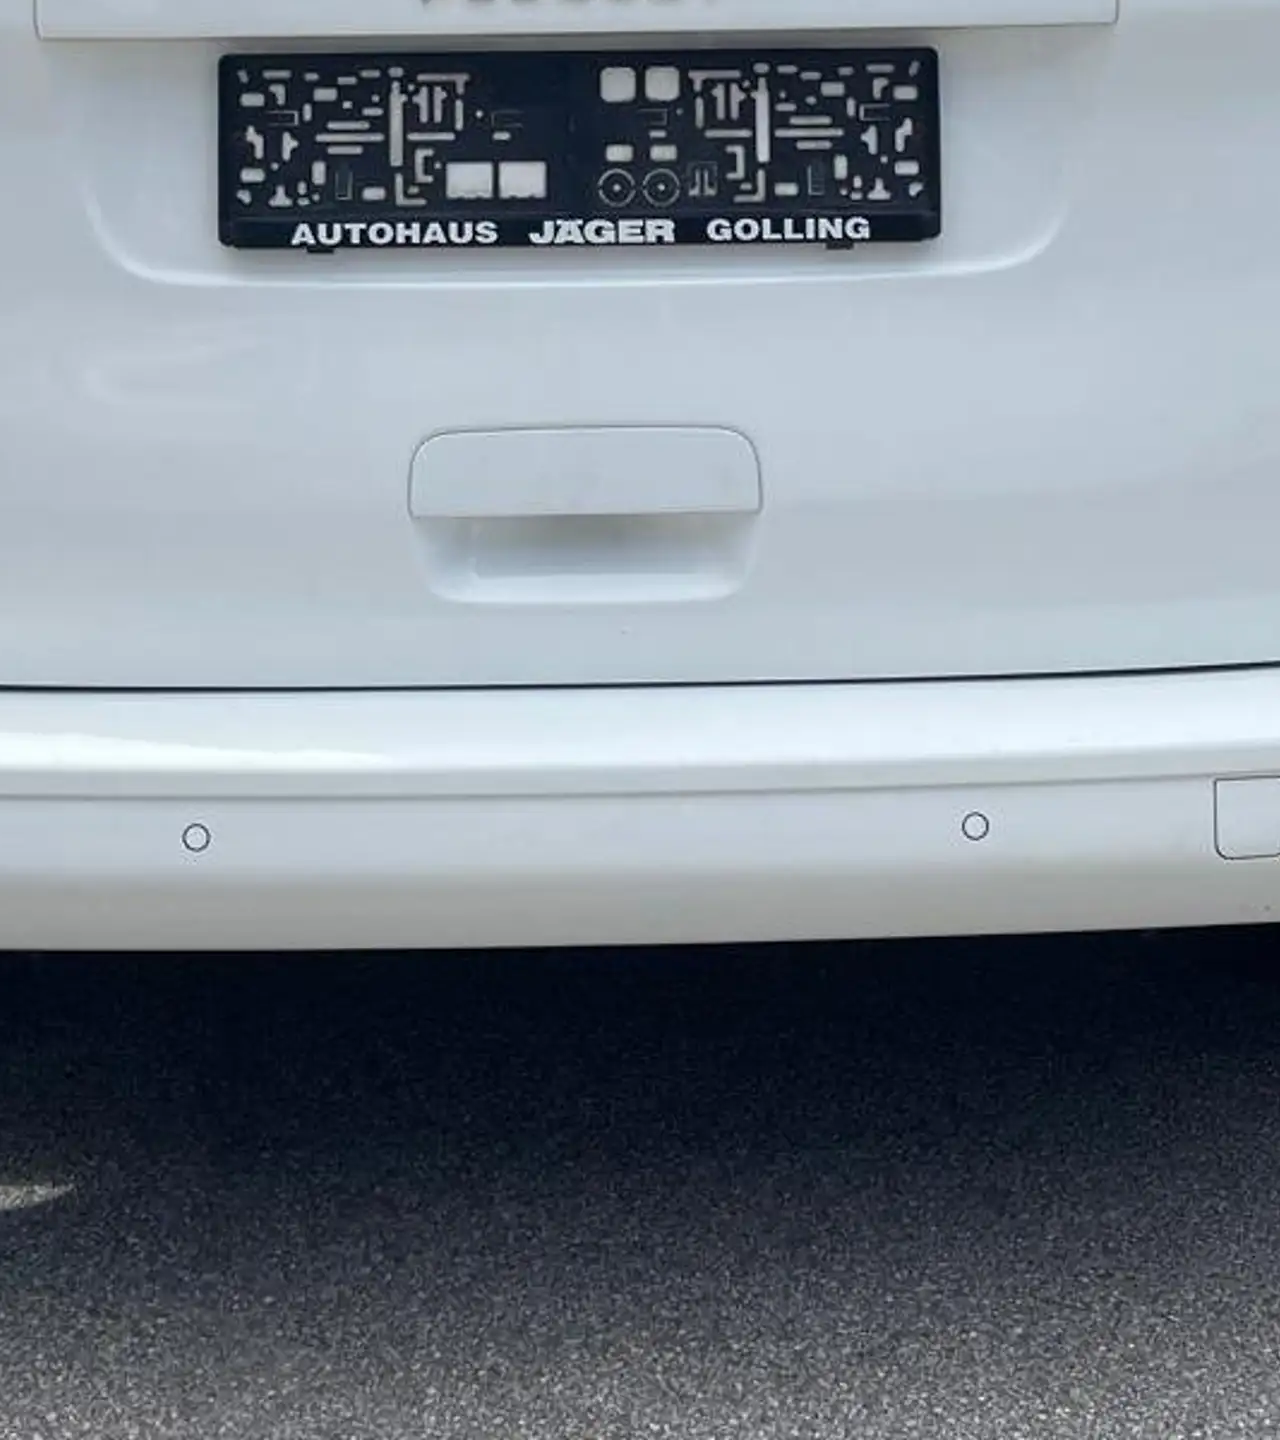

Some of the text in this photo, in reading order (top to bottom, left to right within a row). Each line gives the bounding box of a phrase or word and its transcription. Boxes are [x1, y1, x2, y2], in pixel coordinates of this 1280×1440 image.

[291, 218, 870, 246] AUTOHAUS JÄGER GOLLING
